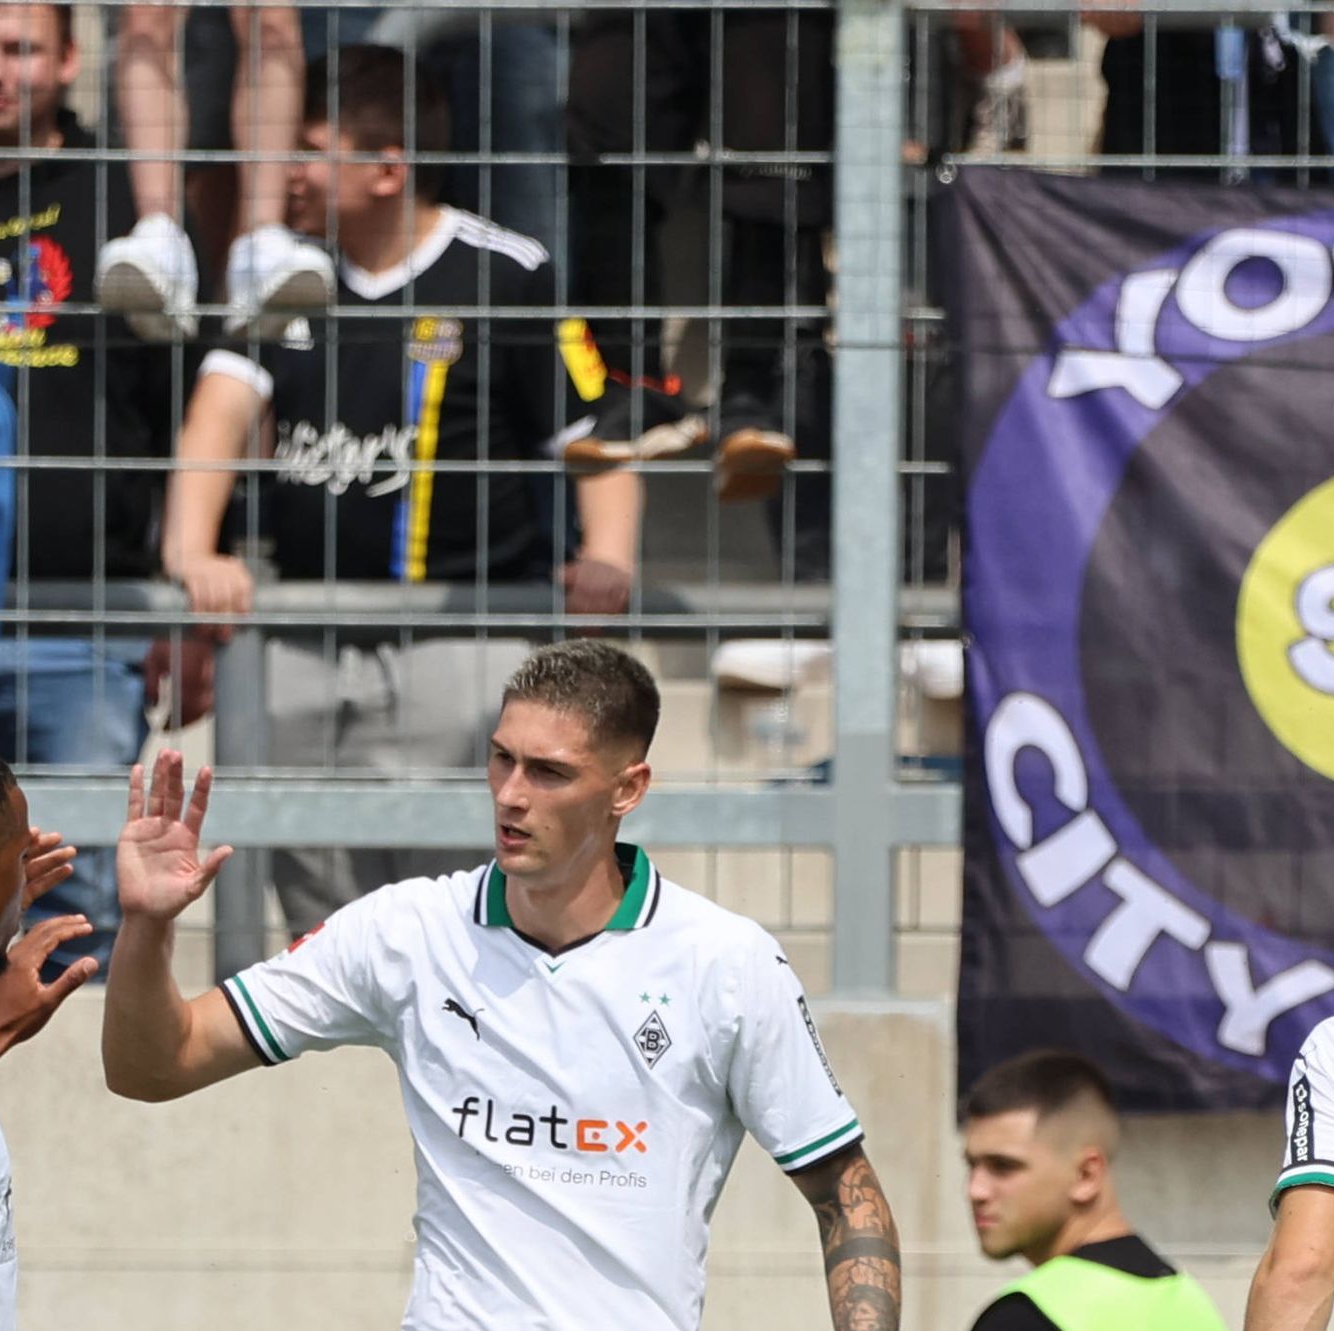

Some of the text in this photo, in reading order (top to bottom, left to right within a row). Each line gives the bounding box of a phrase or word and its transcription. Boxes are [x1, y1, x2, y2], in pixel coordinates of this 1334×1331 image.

[528, 1166, 648, 1189] bei den Profis
